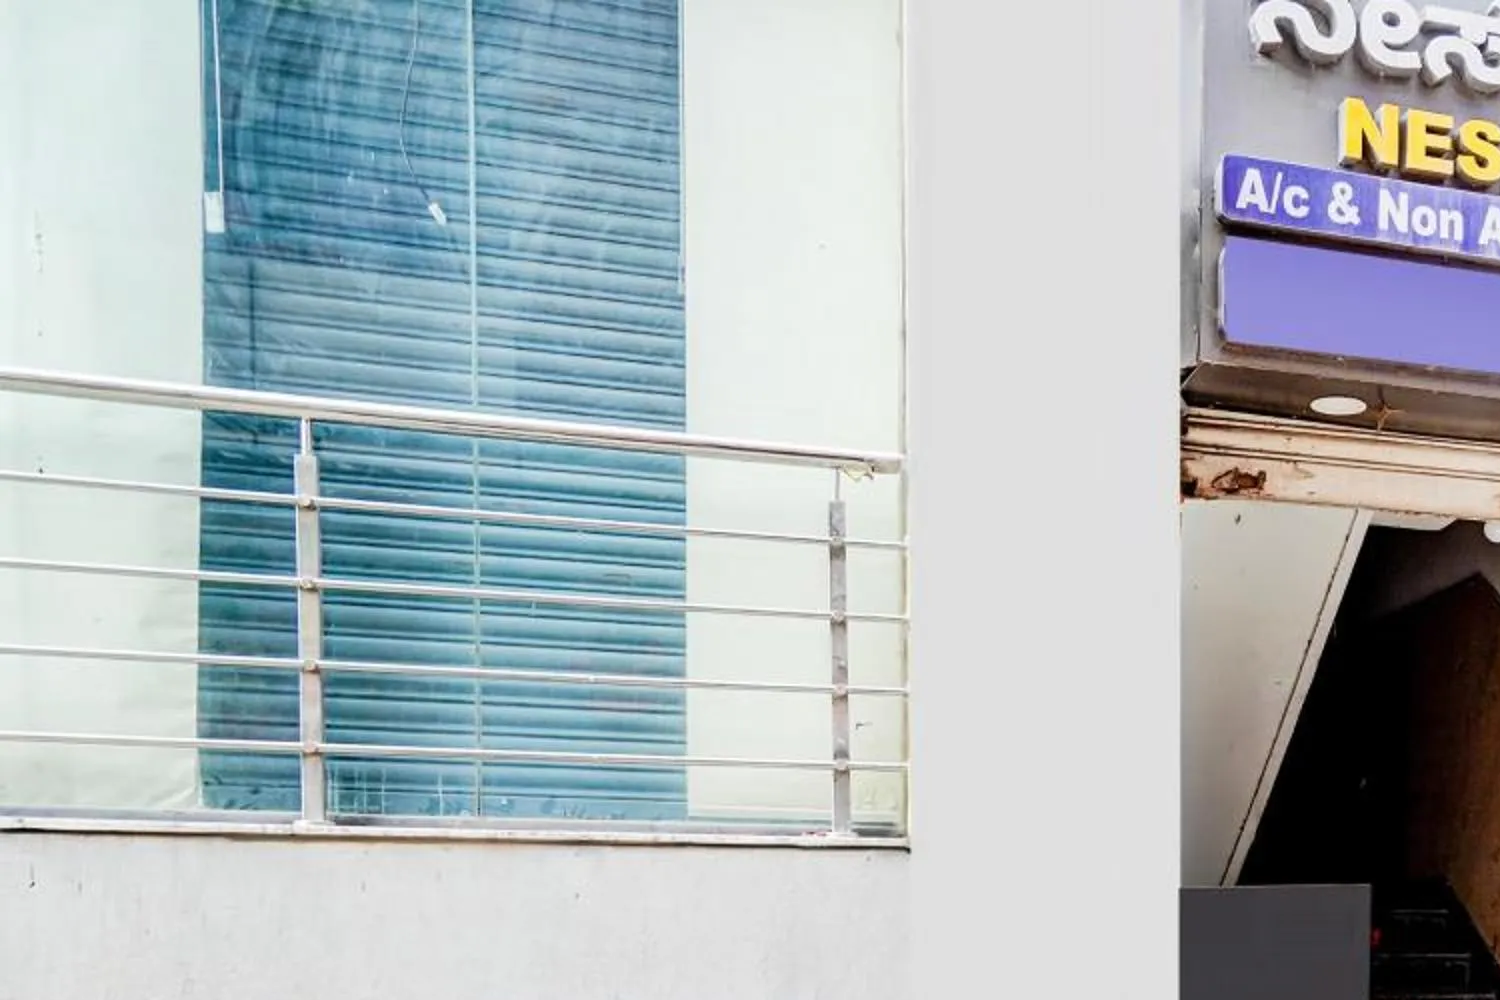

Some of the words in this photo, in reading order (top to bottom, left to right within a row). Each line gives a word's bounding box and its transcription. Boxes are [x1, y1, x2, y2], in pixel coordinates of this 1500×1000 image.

[1235, 167, 1310, 217] A/c
[1327, 181, 1361, 226] &
[1378, 188, 1464, 242] Non
